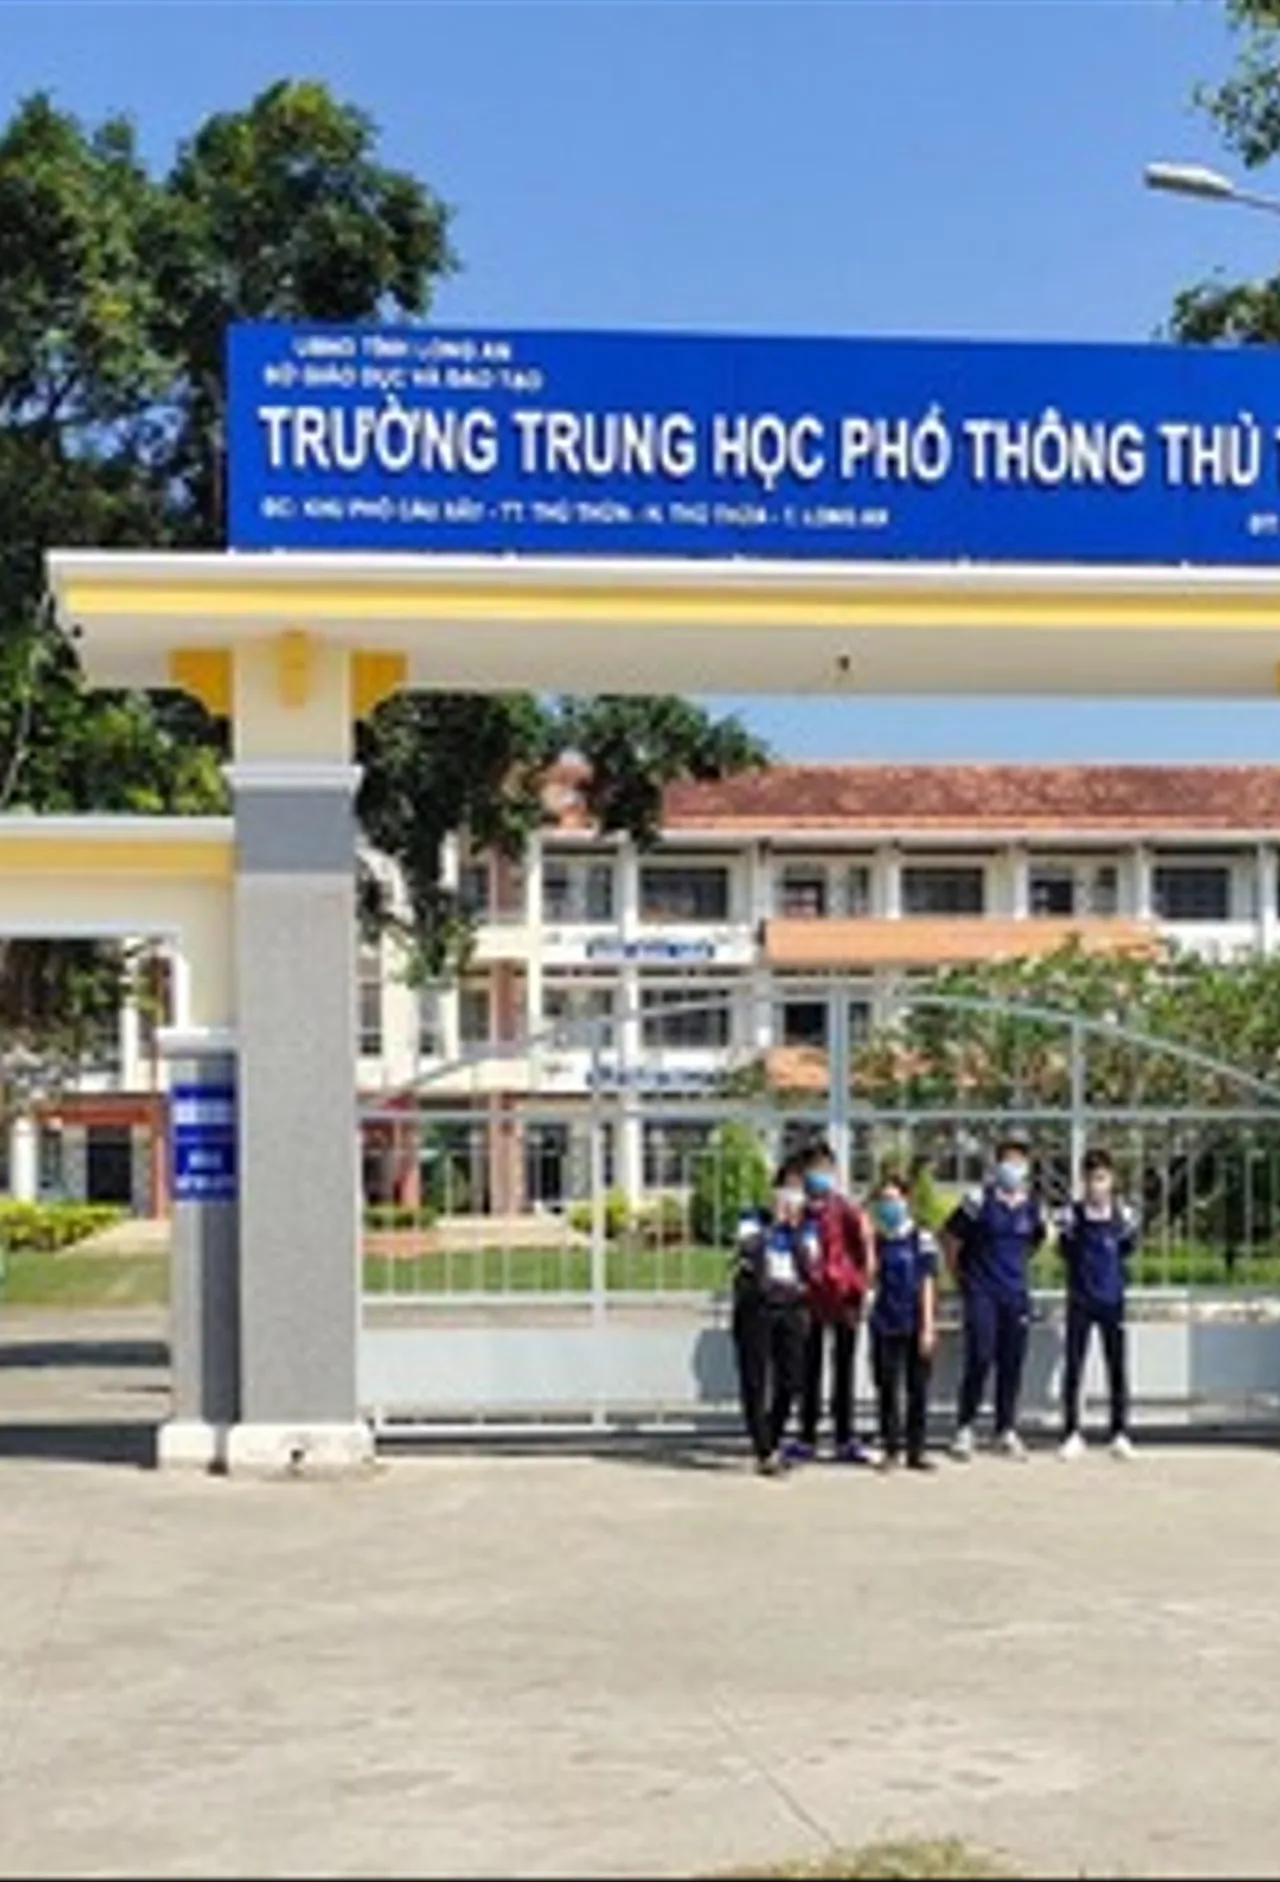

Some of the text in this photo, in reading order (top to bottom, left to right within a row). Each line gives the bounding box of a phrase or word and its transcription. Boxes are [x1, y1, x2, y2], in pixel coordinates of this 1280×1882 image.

[419, 338, 477, 361] LONG
[482, 340, 511, 361] AN
[259, 393, 498, 473] TRƯỜNG
[512, 410, 696, 475] TRUNG
[714, 413, 823, 490] HỌC
[841, 402, 951, 481] PHỔ
[965, 407, 1145, 488] THÔNG
[1158, 411, 1261, 487] THỦ
